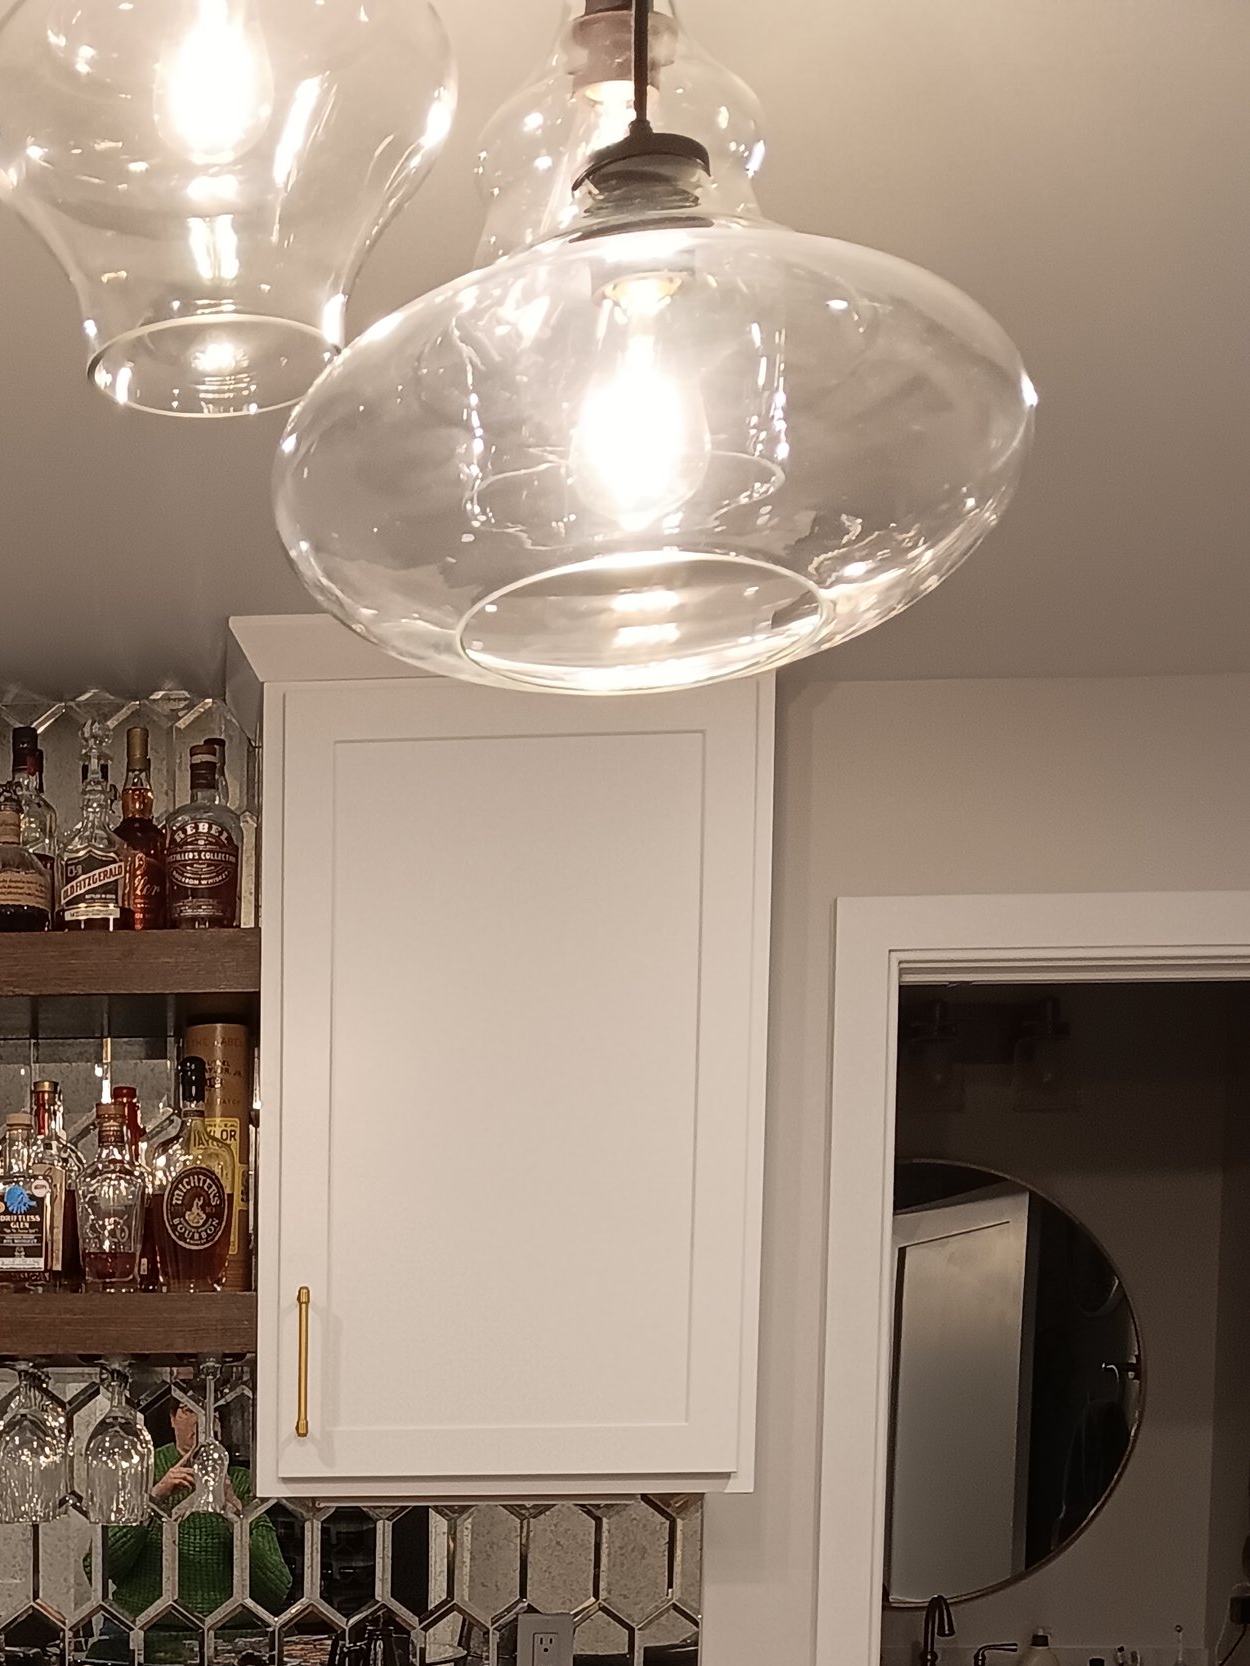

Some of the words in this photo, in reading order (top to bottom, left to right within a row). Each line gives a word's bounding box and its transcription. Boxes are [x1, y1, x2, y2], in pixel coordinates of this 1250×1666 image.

[173, 822, 229, 844] REBEL
[75, 864, 123, 893] FITZGERALD
[172, 1174, 221, 1206] MICHTER'S
[0, 1214, 41, 1222] DRIFTLESS
[9, 1221, 30, 1229] GLEN
[172, 1217, 220, 1240] BOURBON
